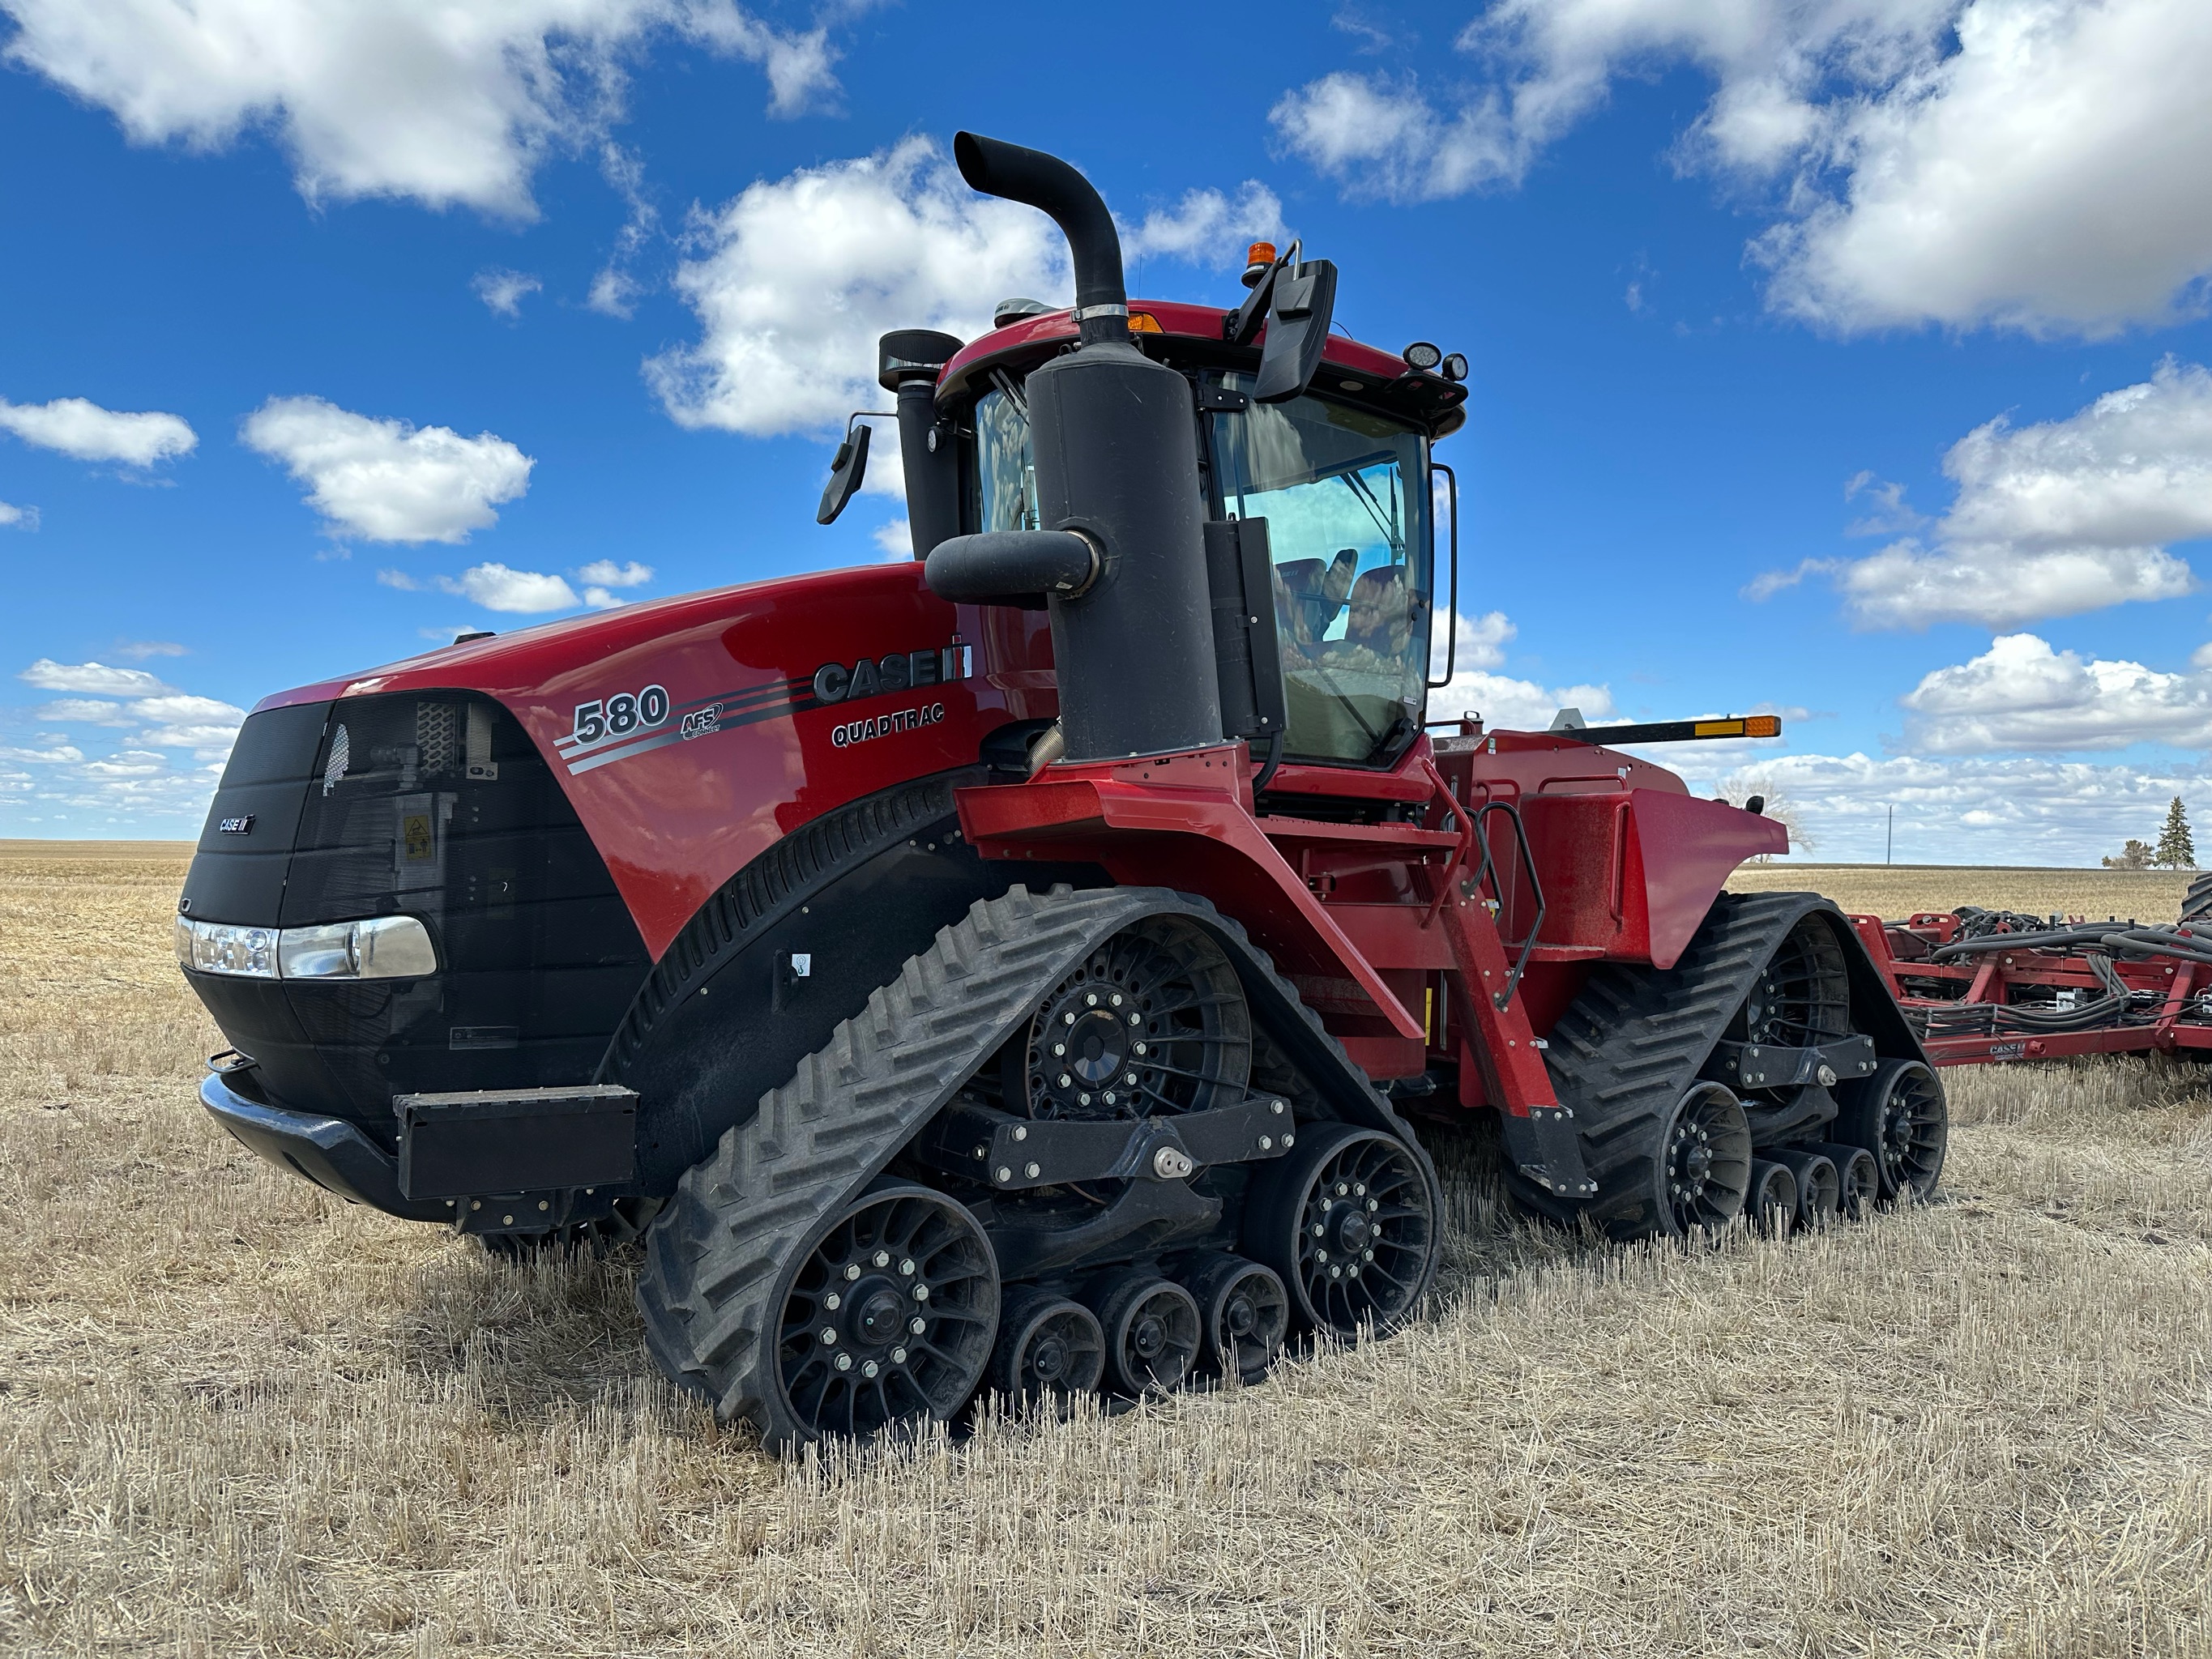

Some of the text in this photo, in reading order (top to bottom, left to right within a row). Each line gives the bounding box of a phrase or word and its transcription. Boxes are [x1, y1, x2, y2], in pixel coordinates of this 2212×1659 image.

[813, 648, 937, 706] CASE
[572, 684, 670, 745] 580
[681, 707, 715, 735] AFS
[831, 702, 945, 748] QUADTRAC
[691, 724, 720, 738] CONNECT
[220, 818, 240, 832] CASE
[1989, 1043, 2017, 1056] CASE
